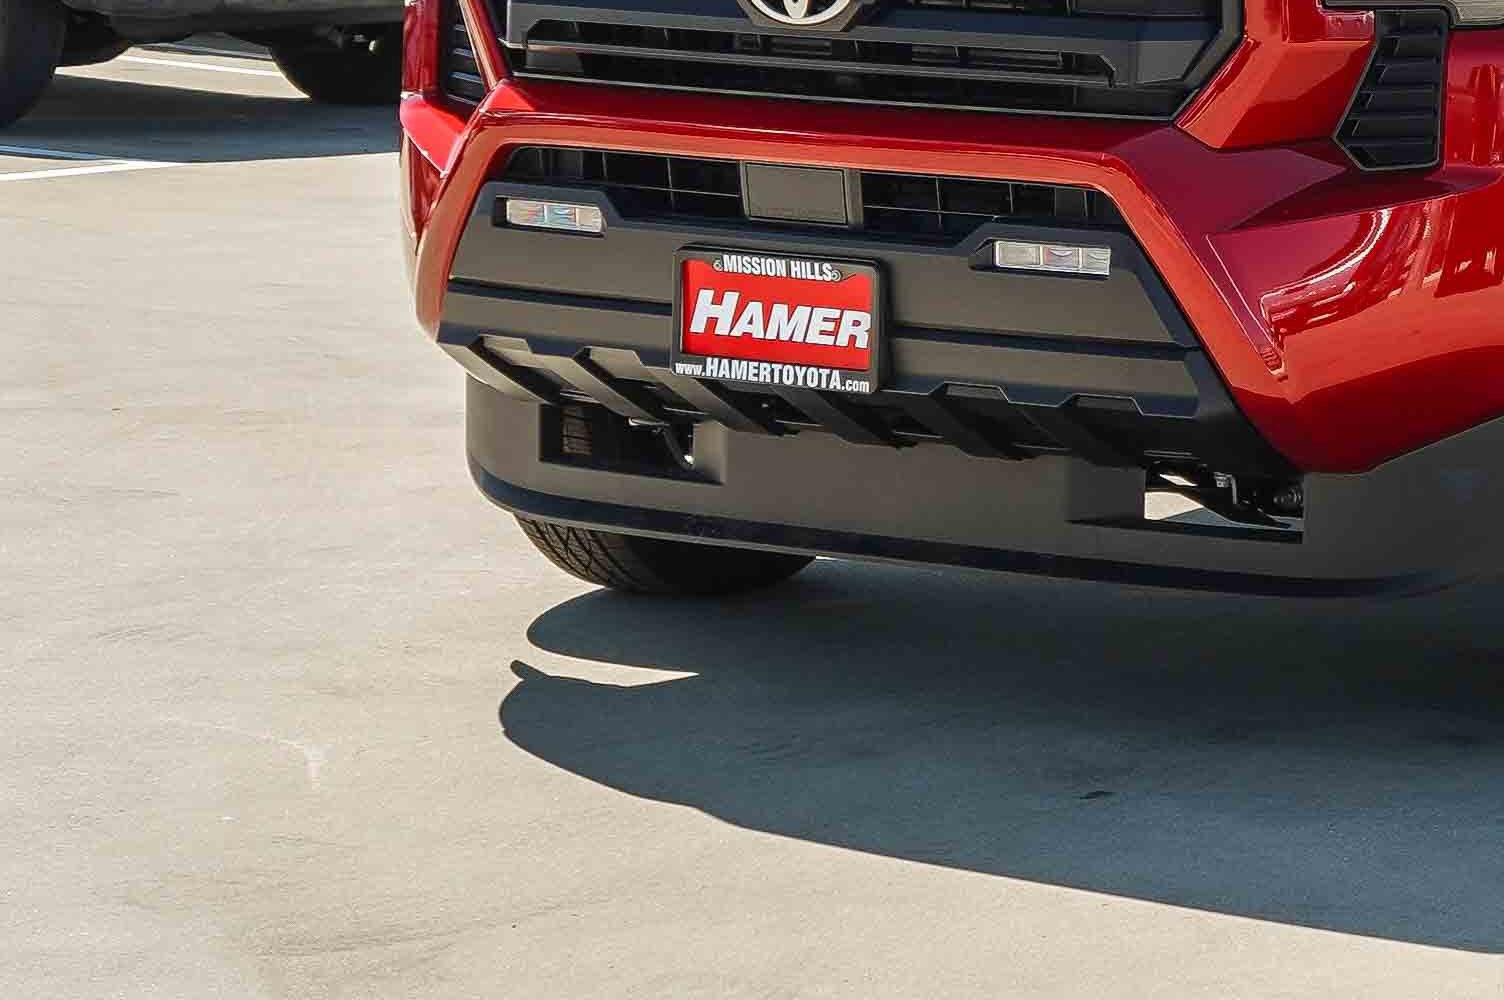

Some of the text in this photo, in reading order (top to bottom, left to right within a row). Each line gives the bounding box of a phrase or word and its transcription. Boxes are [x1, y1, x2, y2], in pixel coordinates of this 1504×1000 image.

[722, 254, 833, 282] MISSION HILLS
[689, 288, 872, 349] HAMER
[674, 357, 870, 392] www.HAMERTOYOTA.com
